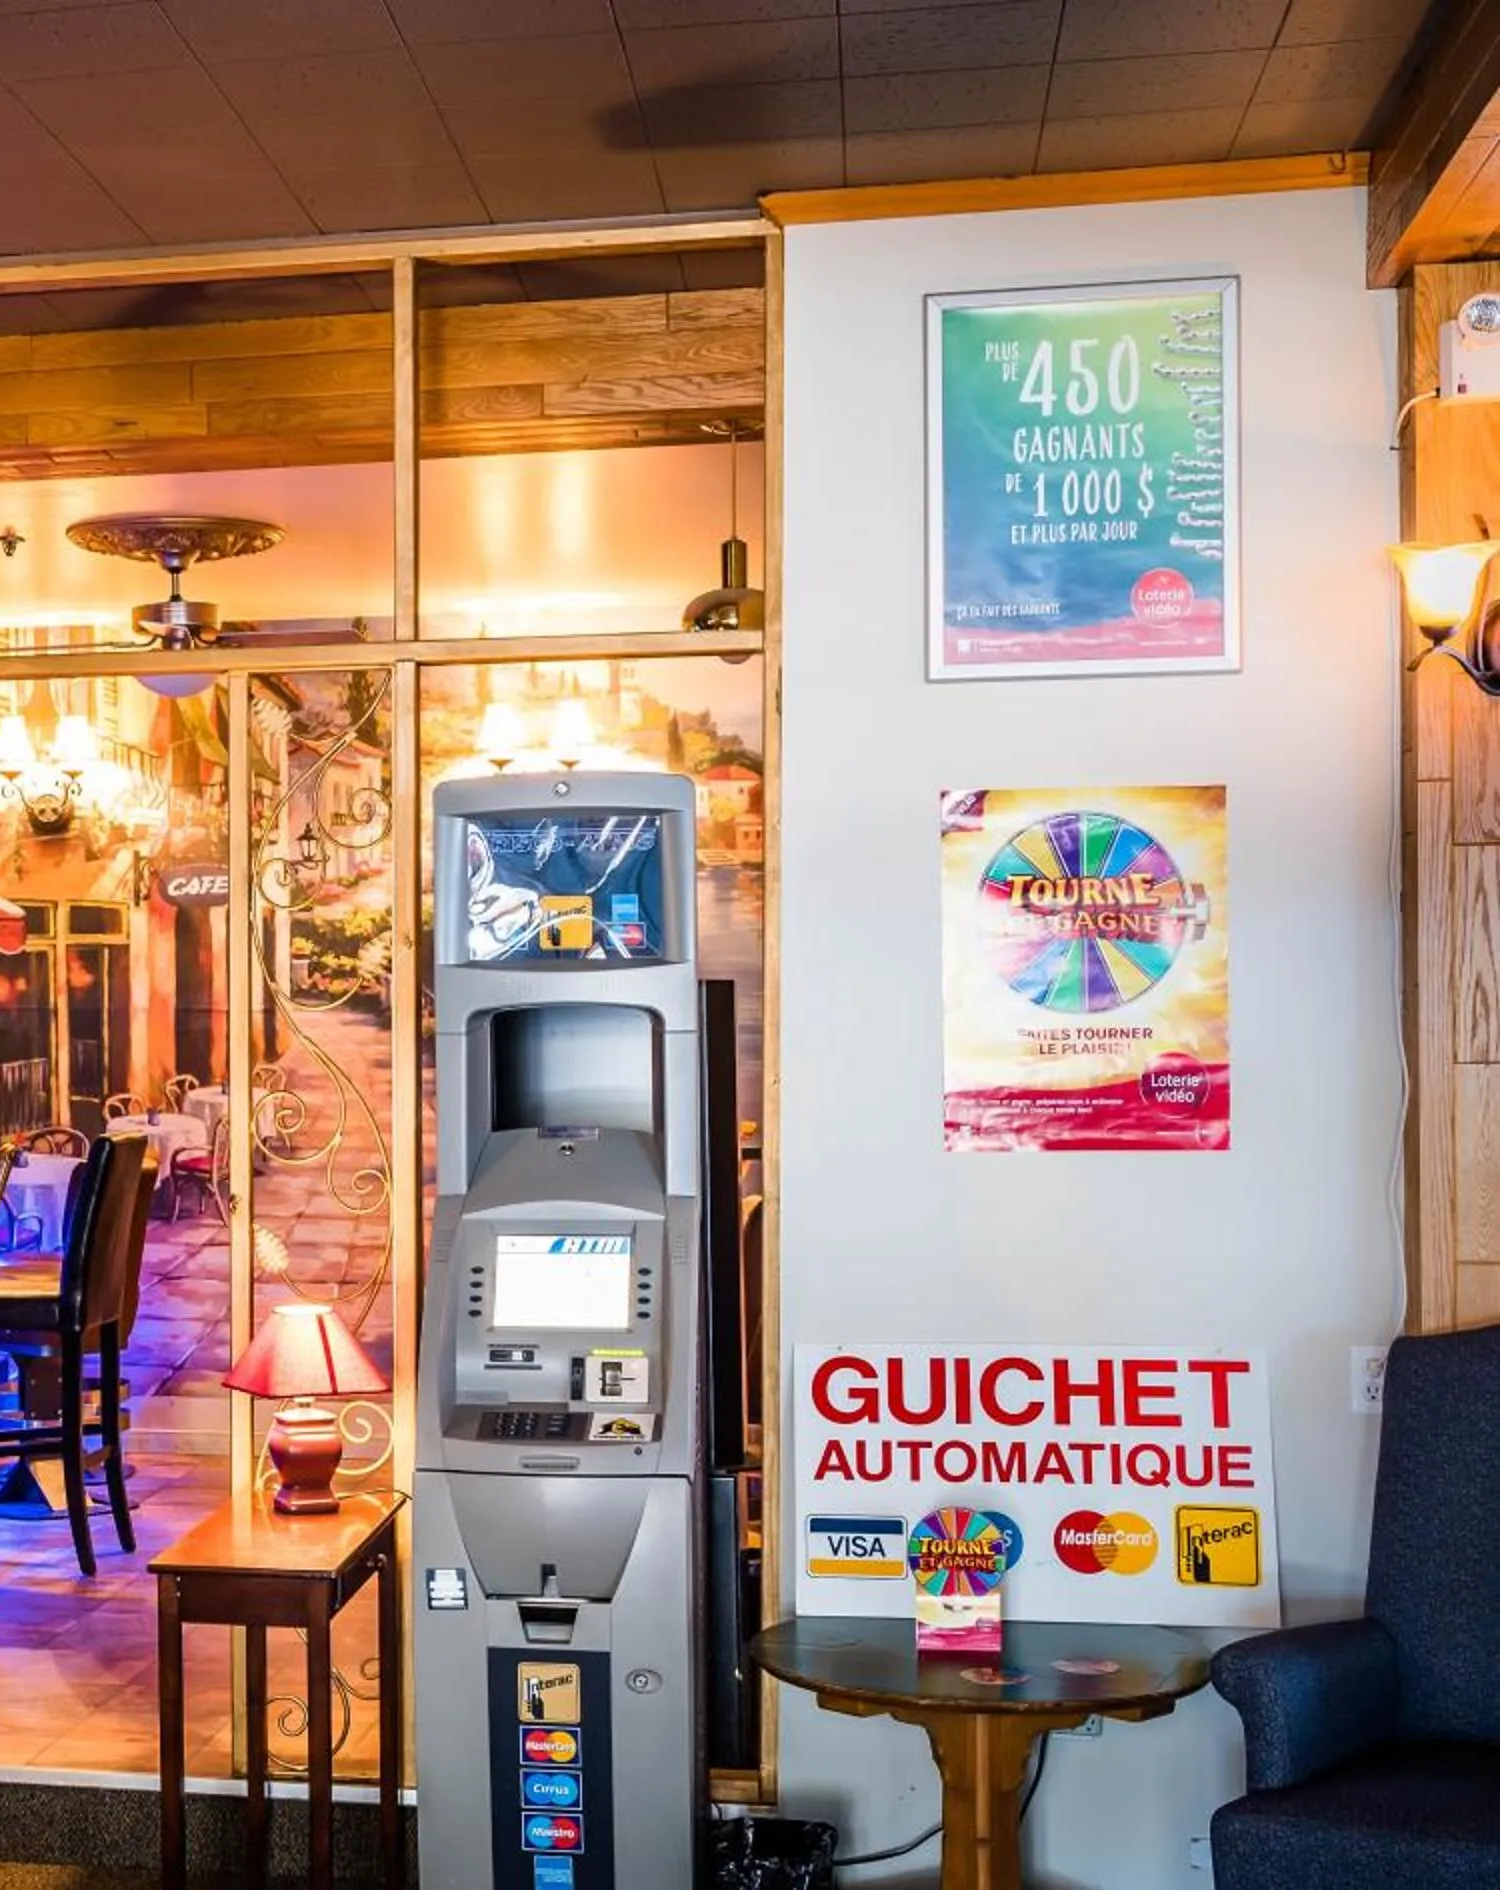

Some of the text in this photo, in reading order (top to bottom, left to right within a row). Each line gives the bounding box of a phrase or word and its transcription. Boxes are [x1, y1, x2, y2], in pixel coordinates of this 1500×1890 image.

[985, 340, 1019, 362] PLUS
[1002, 335, 1141, 417] DE 450
[1012, 421, 1145, 464] GAGNANTS
[1004, 472, 1024, 494] DE
[1033, 471, 1049, 518] 1
[1137, 462, 1155, 519] $
[1011, 520, 1138, 545] ET PLUS PAR JOUR
[1006, 873, 1159, 908] TOURNE
[1053, 910, 1162, 935] GAGNE
[1076, 1027, 1153, 1040] TOURNER
[1039, 1043, 1057, 1055] LE
[1151, 1073, 1200, 1087] Loterie
[1156, 1087, 1195, 1103] vidéo
[811, 1355, 1251, 1429] GUICHET
[813, 1439, 1255, 1489] AUTOMATIQUE
[826, 1535, 887, 1558] VISA
[920, 1537, 996, 1555] TOURNE
[1060, 1528, 1153, 1545] MasterCard
[920, 1556, 996, 1570] ET GAGNE
[533, 1783, 570, 1795] Cirrus
[531, 1826, 575, 1839] Maestro
